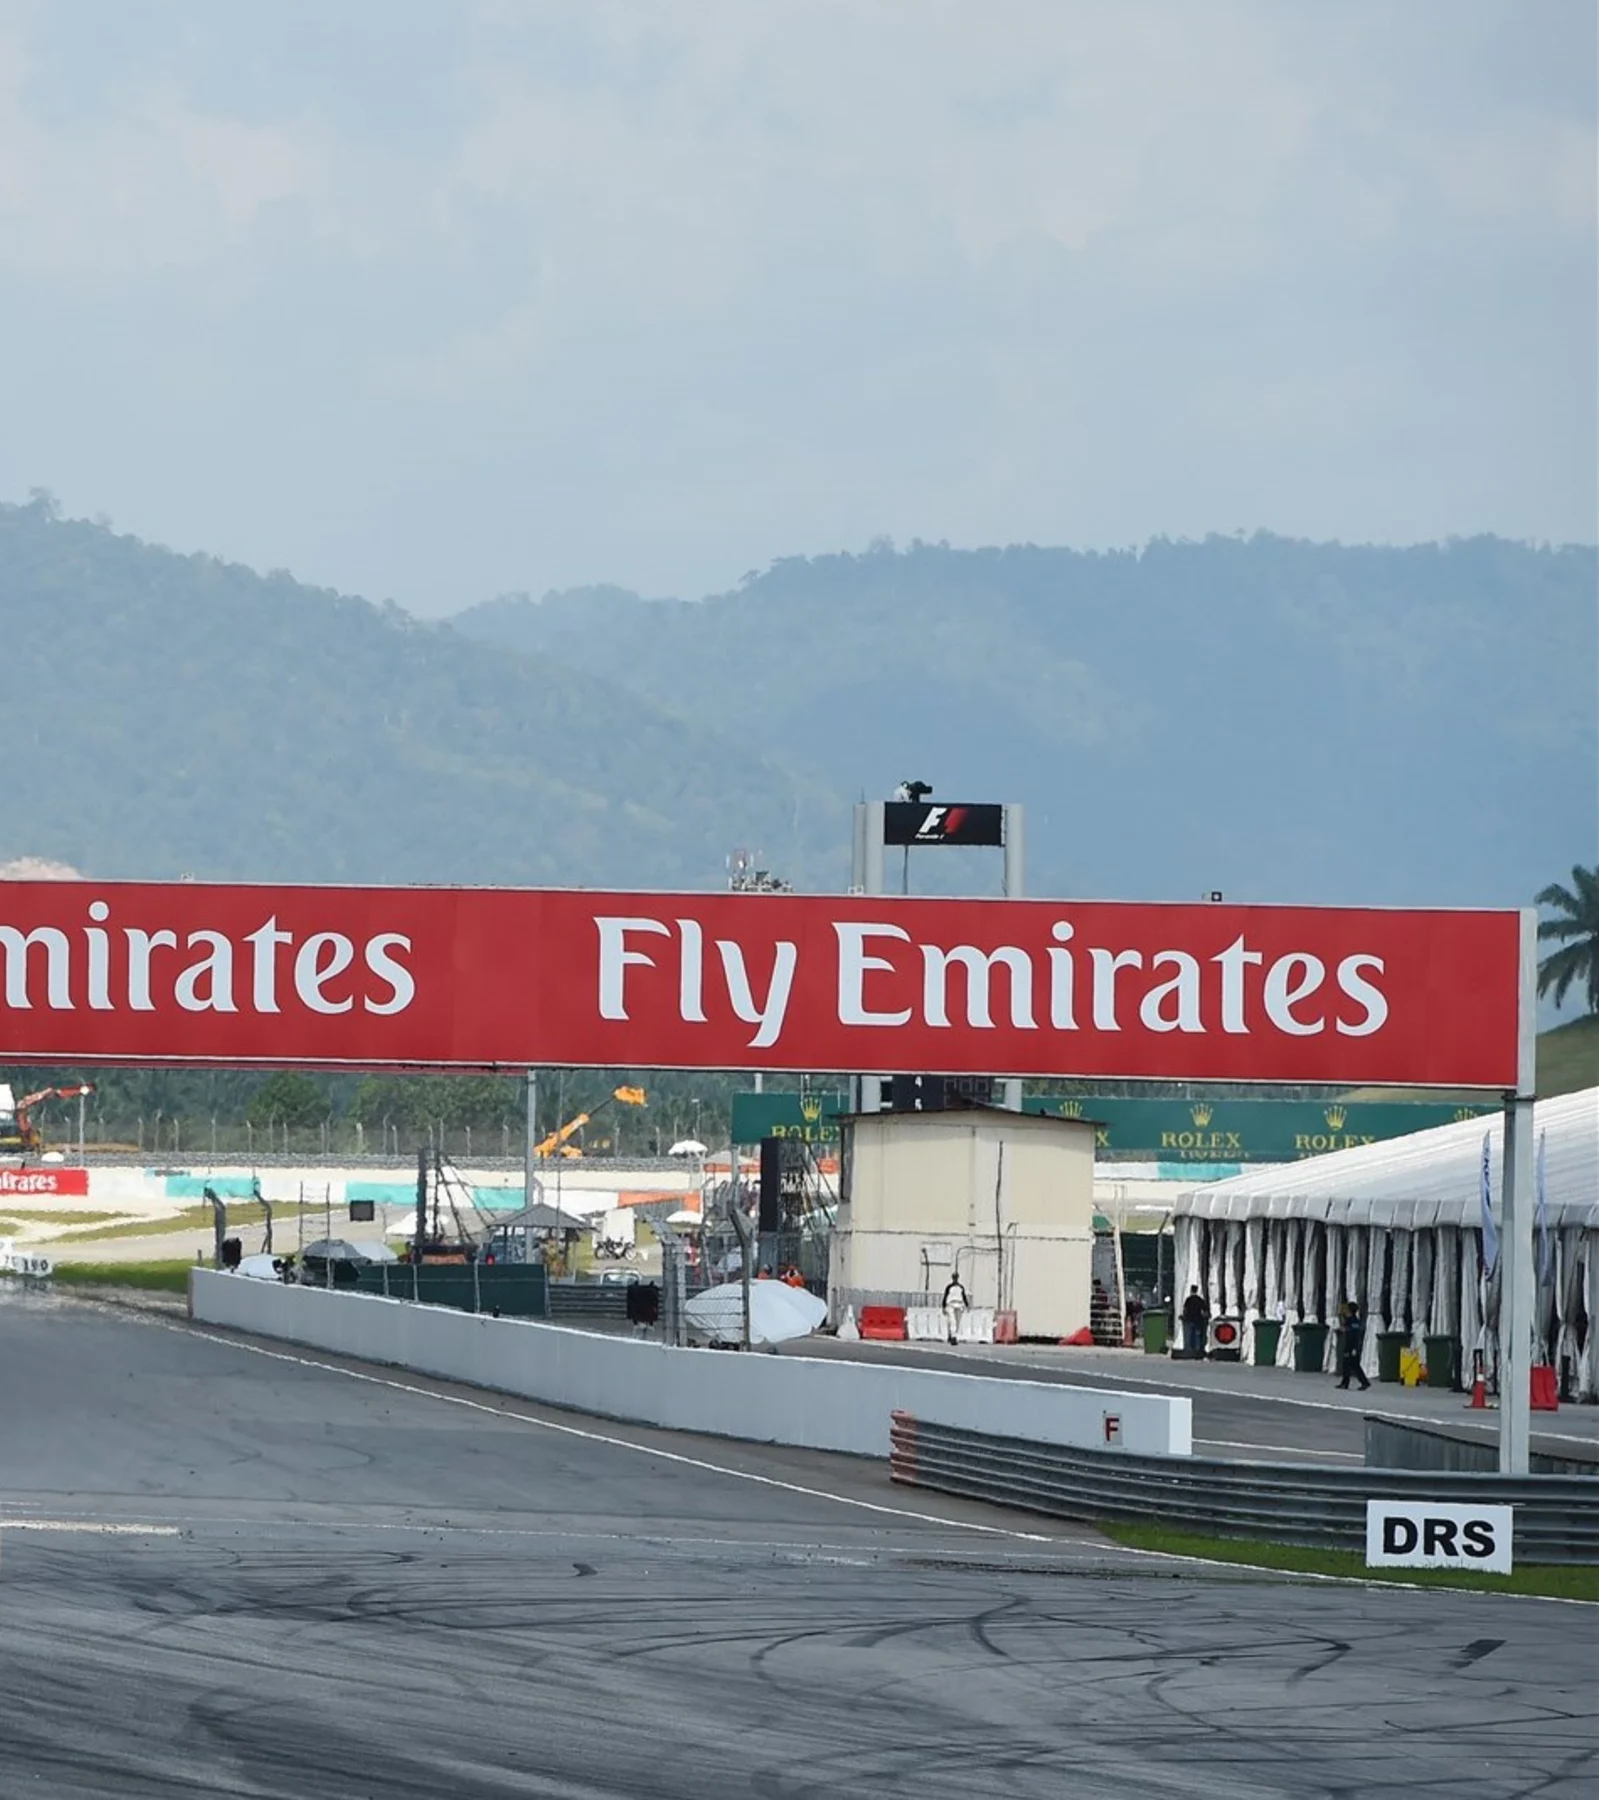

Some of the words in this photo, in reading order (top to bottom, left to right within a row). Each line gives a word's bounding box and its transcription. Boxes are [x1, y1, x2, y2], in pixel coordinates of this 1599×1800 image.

[593, 916, 798, 1049] Fly
[831, 919, 1388, 1038] Emirates
[1161, 1131, 1241, 1148] ROLEX
[1105, 1417, 1119, 1442] F
[1383, 1517, 1495, 1557] DRS
